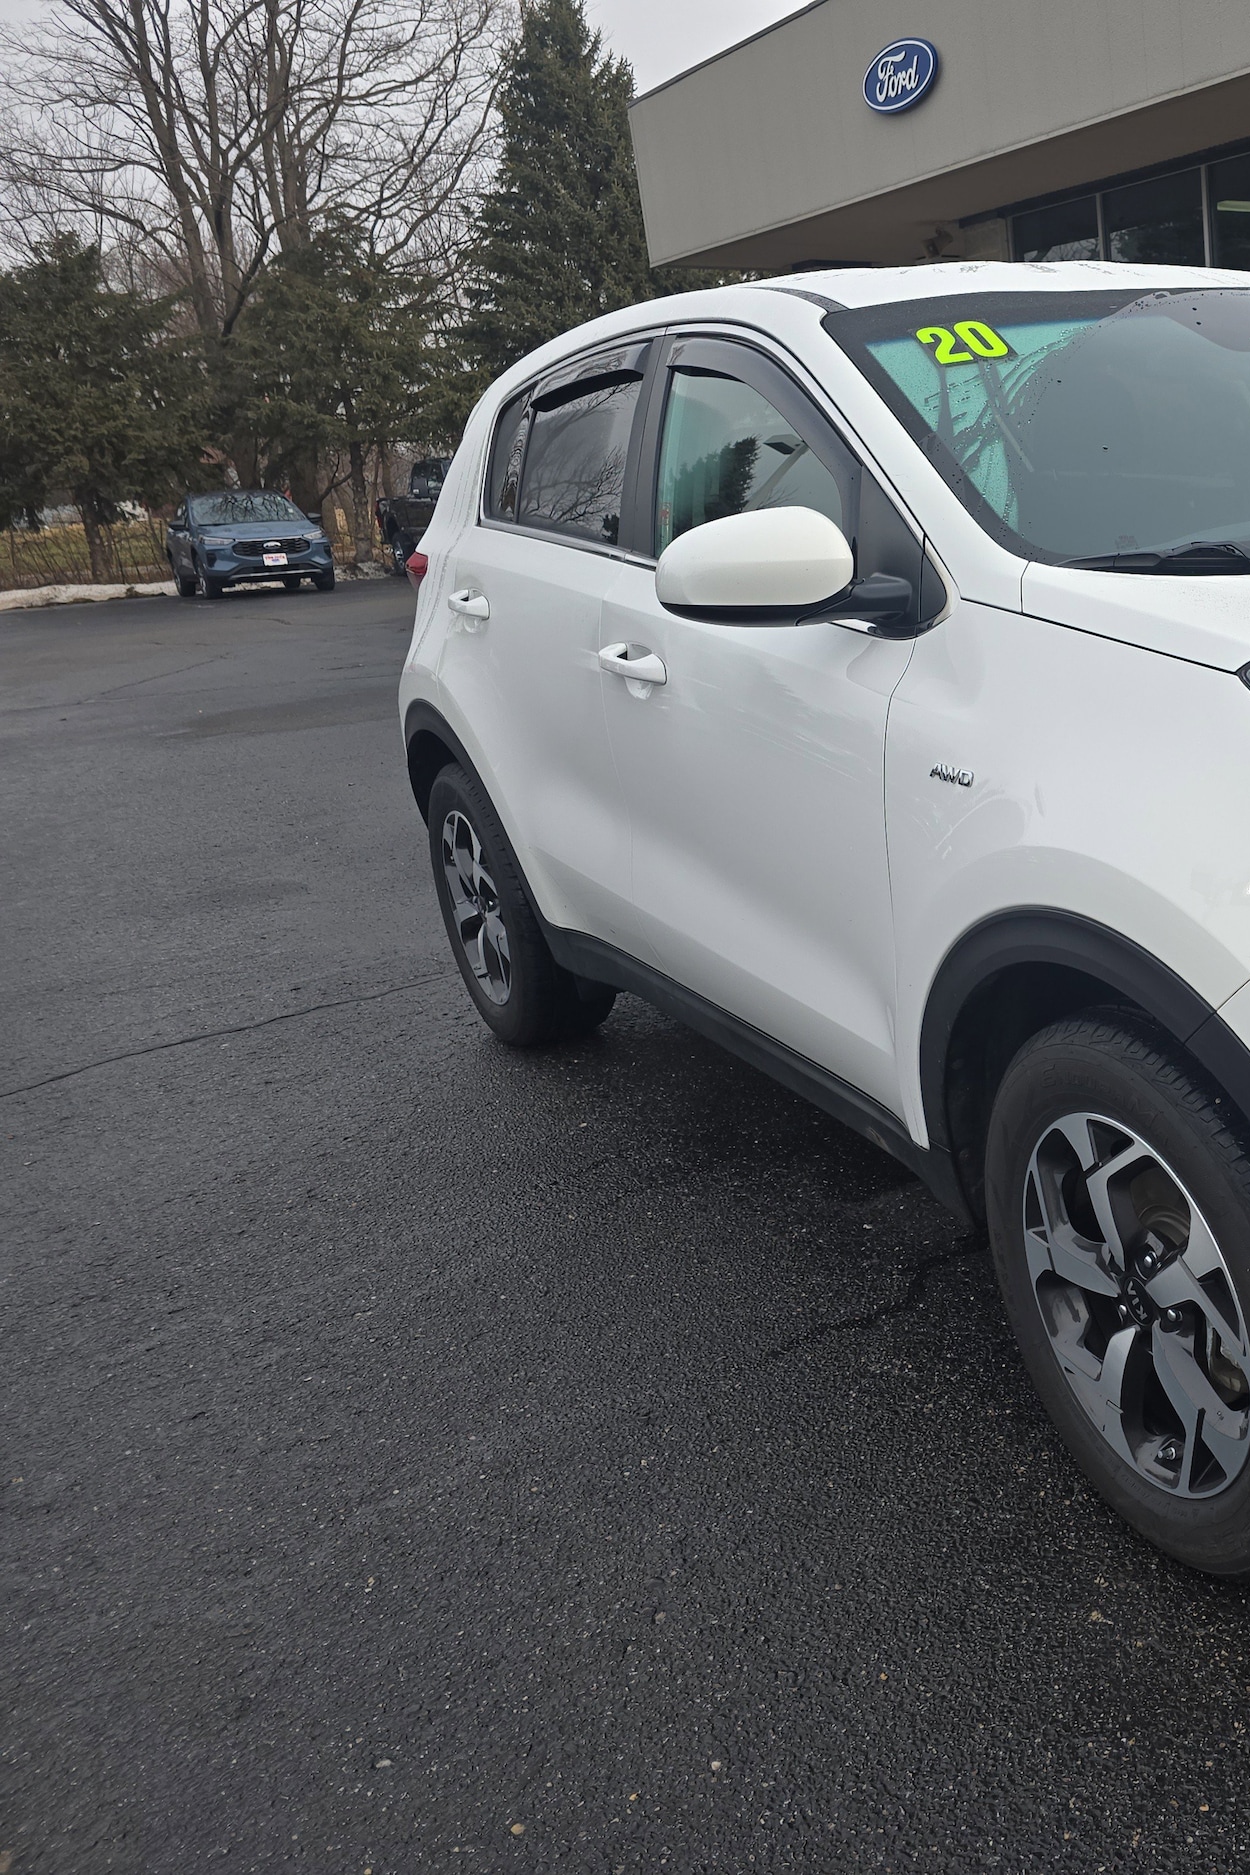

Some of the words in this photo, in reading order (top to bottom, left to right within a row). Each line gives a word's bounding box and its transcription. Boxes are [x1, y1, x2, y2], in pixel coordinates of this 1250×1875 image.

[876, 50, 919, 103] Ford
[916, 320, 1009, 364] 20
[929, 762, 974, 788] AWD
[1127, 1280, 1148, 1321] KIA
